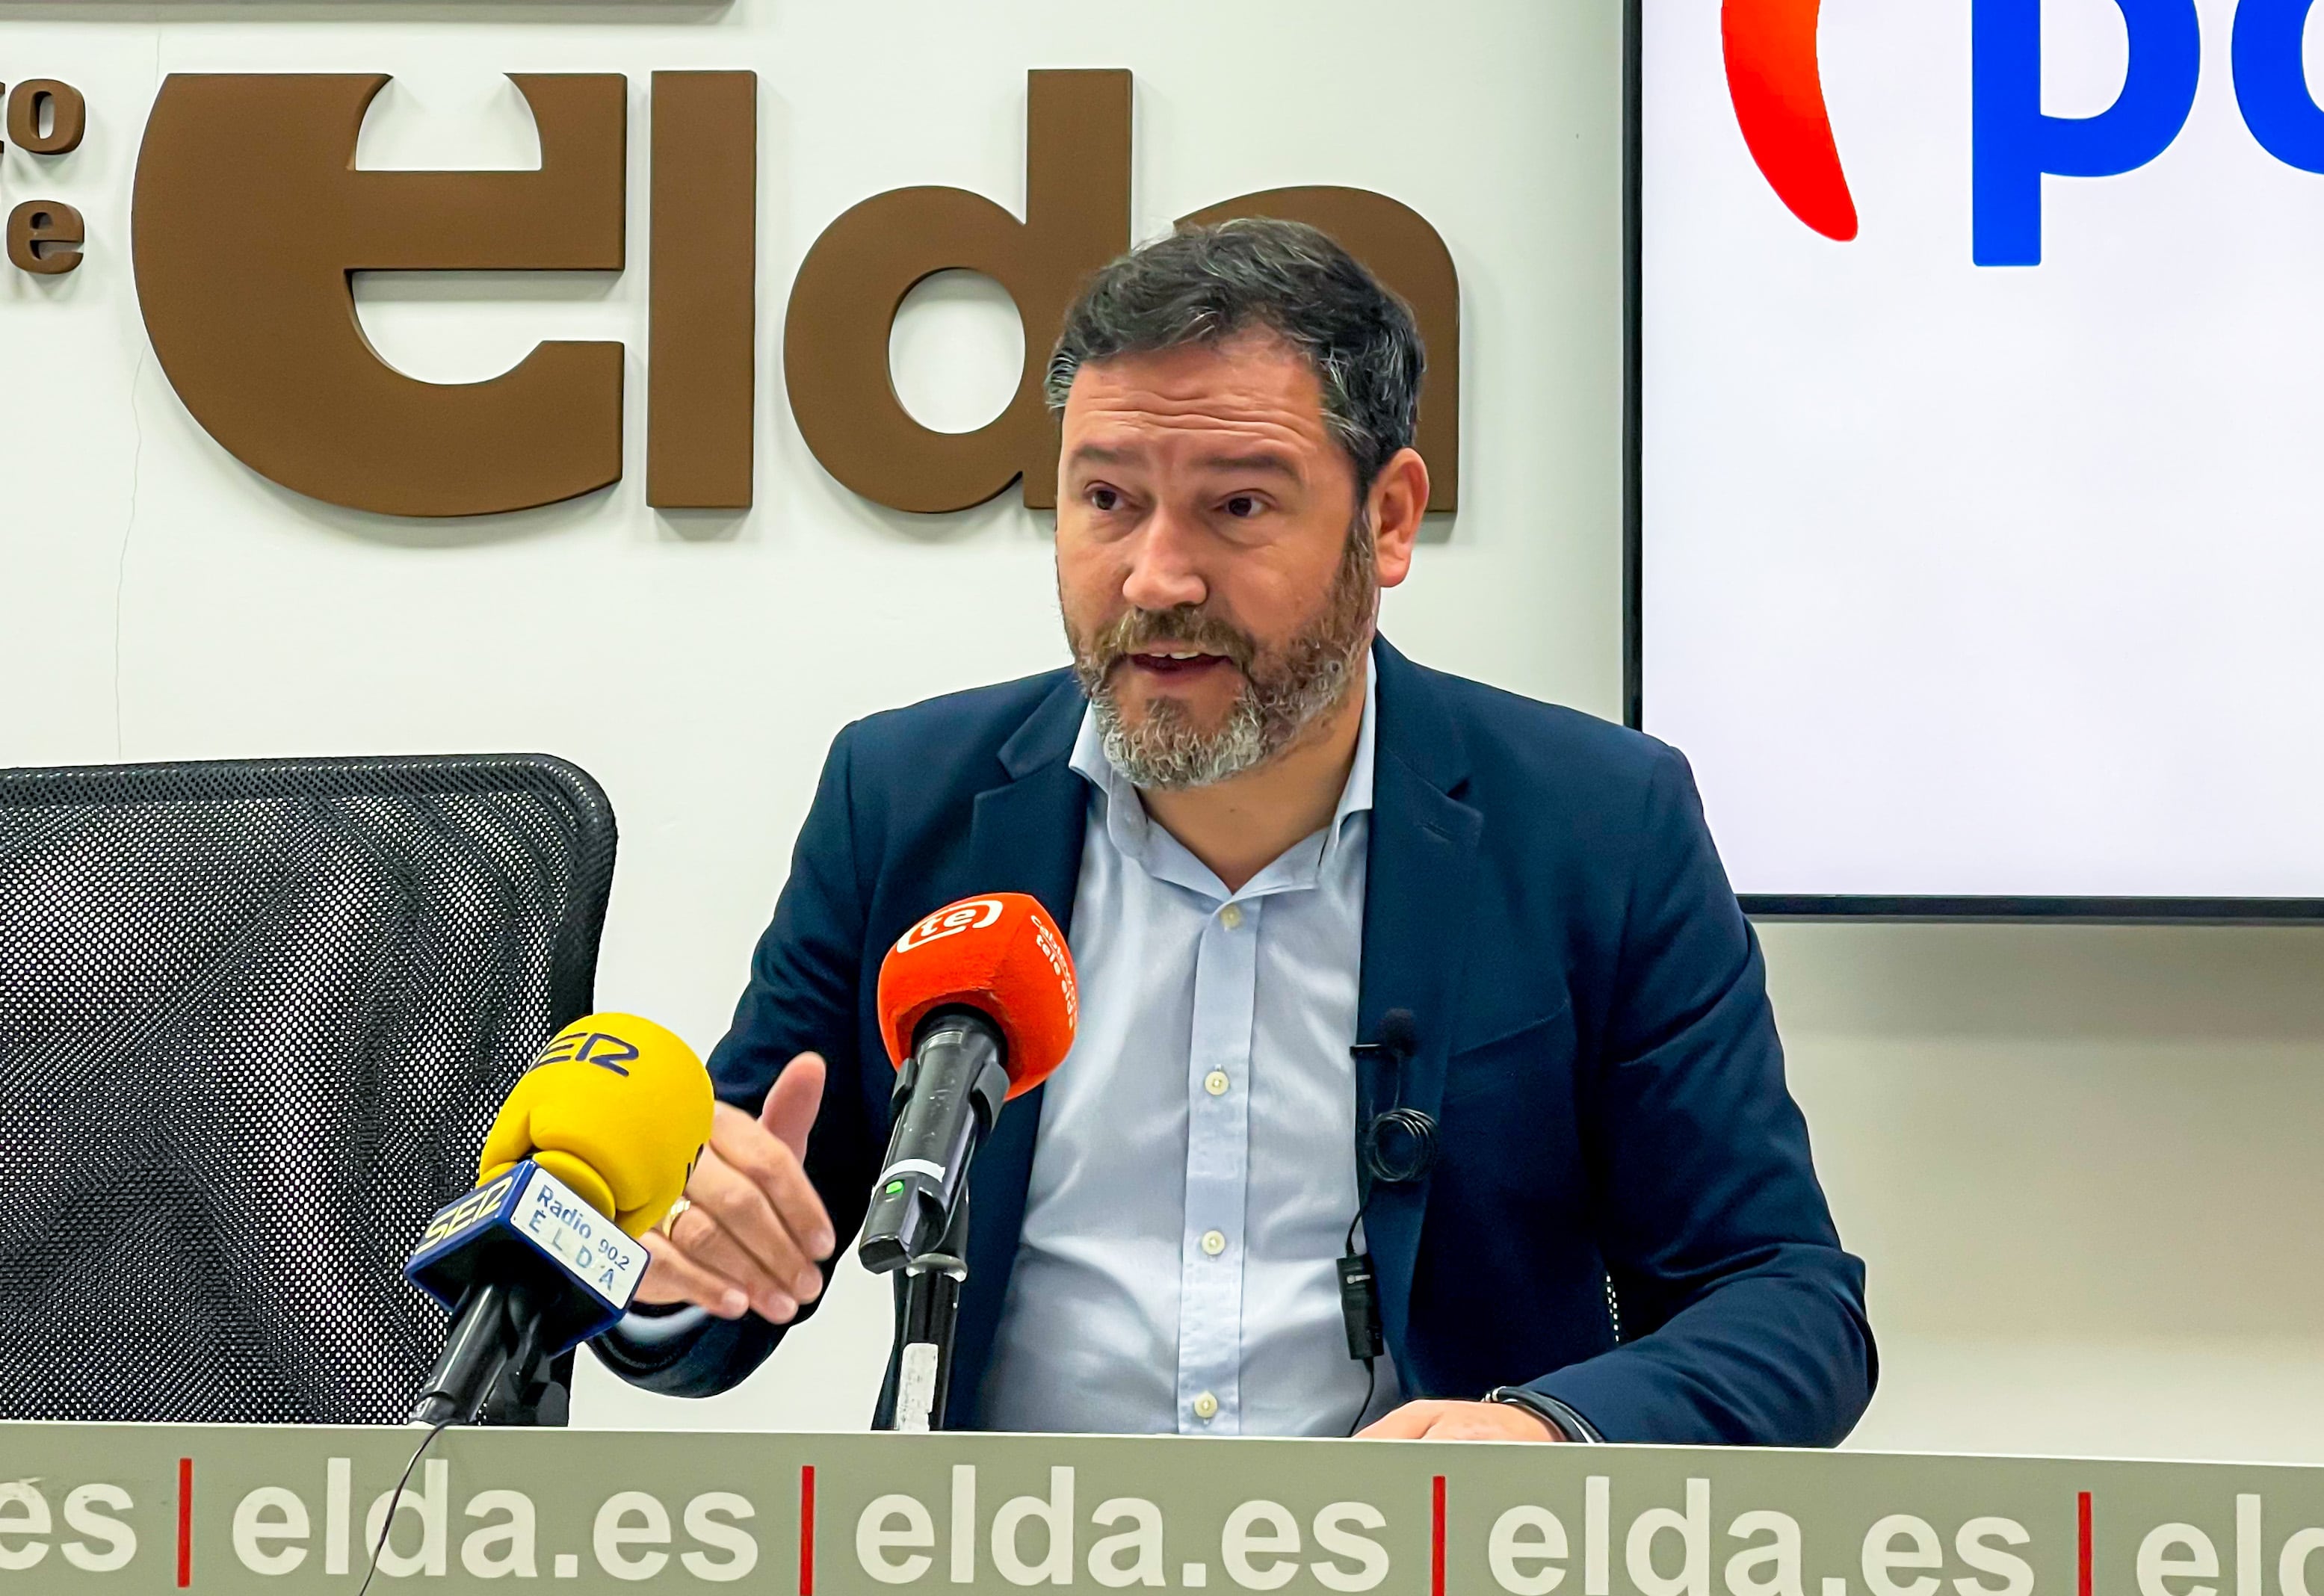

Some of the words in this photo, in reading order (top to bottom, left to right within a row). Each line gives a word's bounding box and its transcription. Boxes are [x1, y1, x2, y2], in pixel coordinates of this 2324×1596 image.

[0, 78, 85, 155] o
[414, 1176, 513, 1256] SER
[536, 1184, 592, 1240] Radio
[598, 1238, 631, 1272] 90.2
[232, 1457, 759, 1582] elda.es
[855, 1464, 1390, 1592] elda.es
[1487, 1474, 2036, 1596] elda.es
